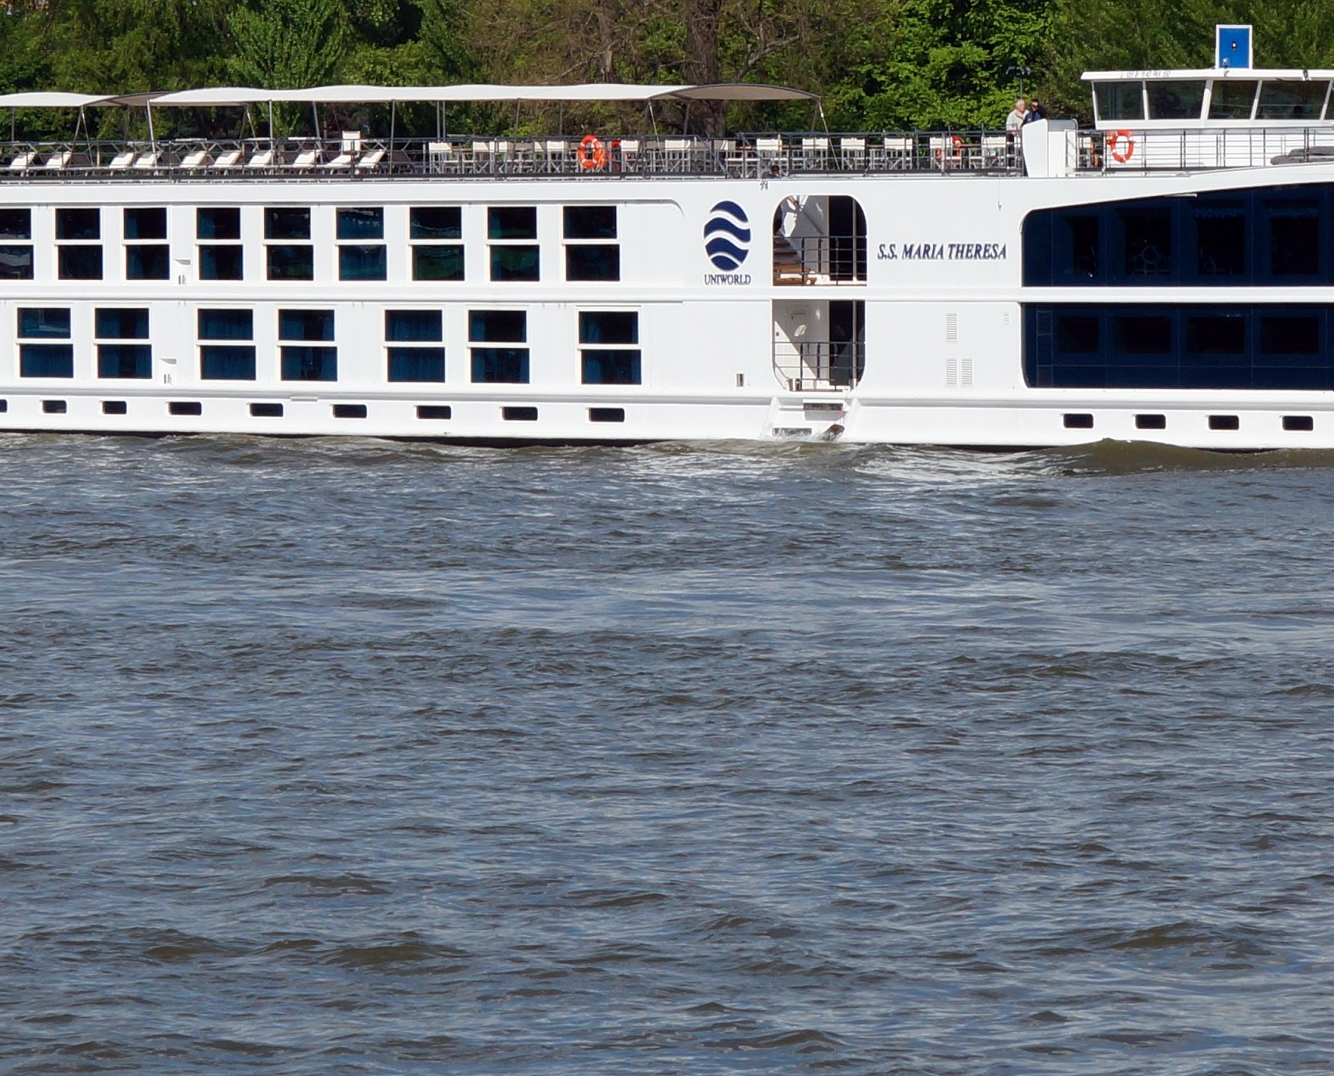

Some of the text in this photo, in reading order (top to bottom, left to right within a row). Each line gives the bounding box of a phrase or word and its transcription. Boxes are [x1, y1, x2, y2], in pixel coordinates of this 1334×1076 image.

[877, 243, 1007, 260] S.S. MARIA THERESA
[704, 274, 752, 286] UNIWORLD
